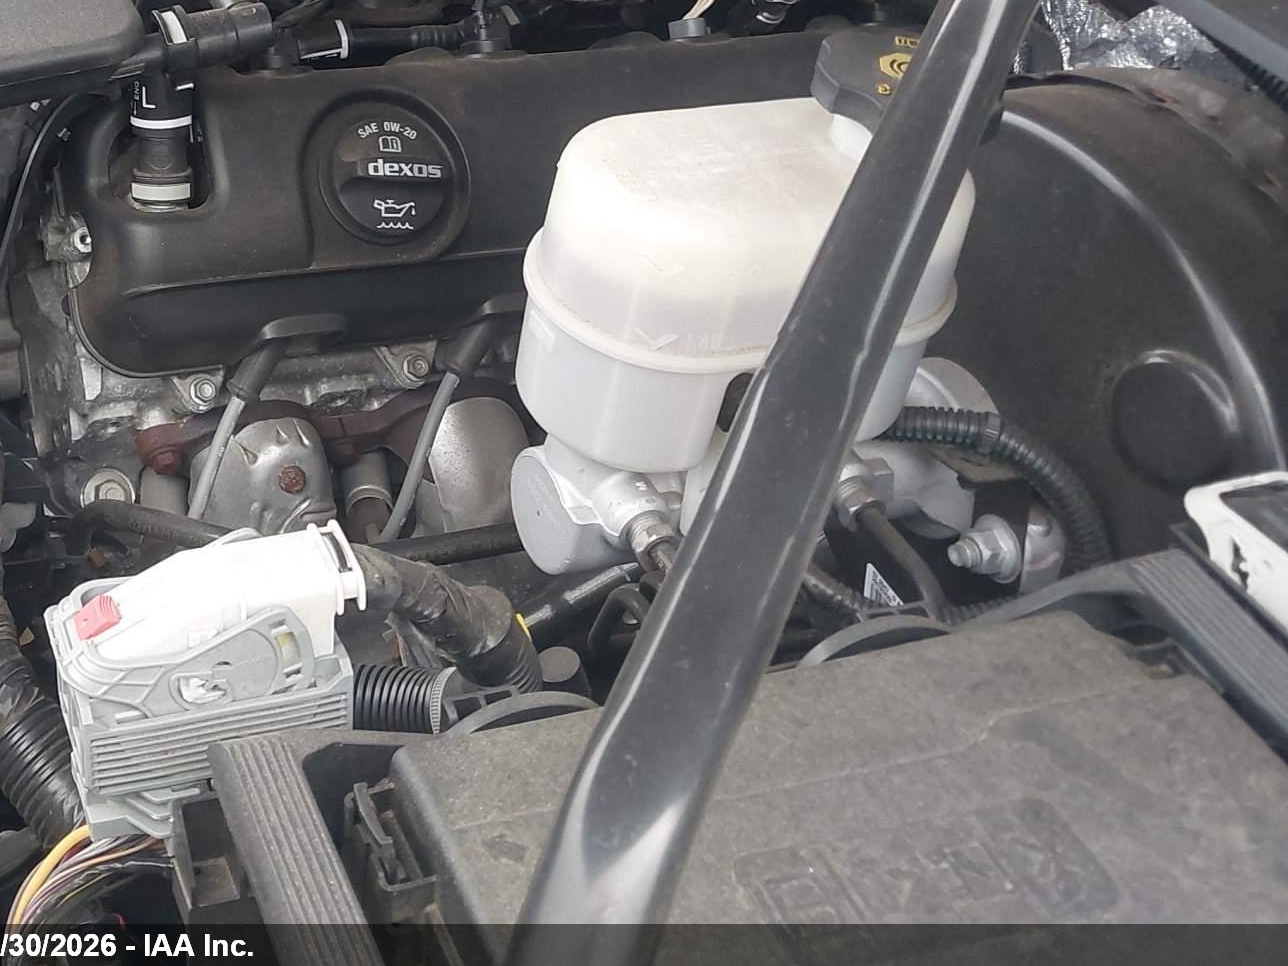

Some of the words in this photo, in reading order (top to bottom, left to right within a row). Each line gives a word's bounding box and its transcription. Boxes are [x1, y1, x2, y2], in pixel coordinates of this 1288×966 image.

[358, 122, 379, 138] SAE
[383, 121, 417, 140] 0W-20
[367, 159, 444, 178] dexos
